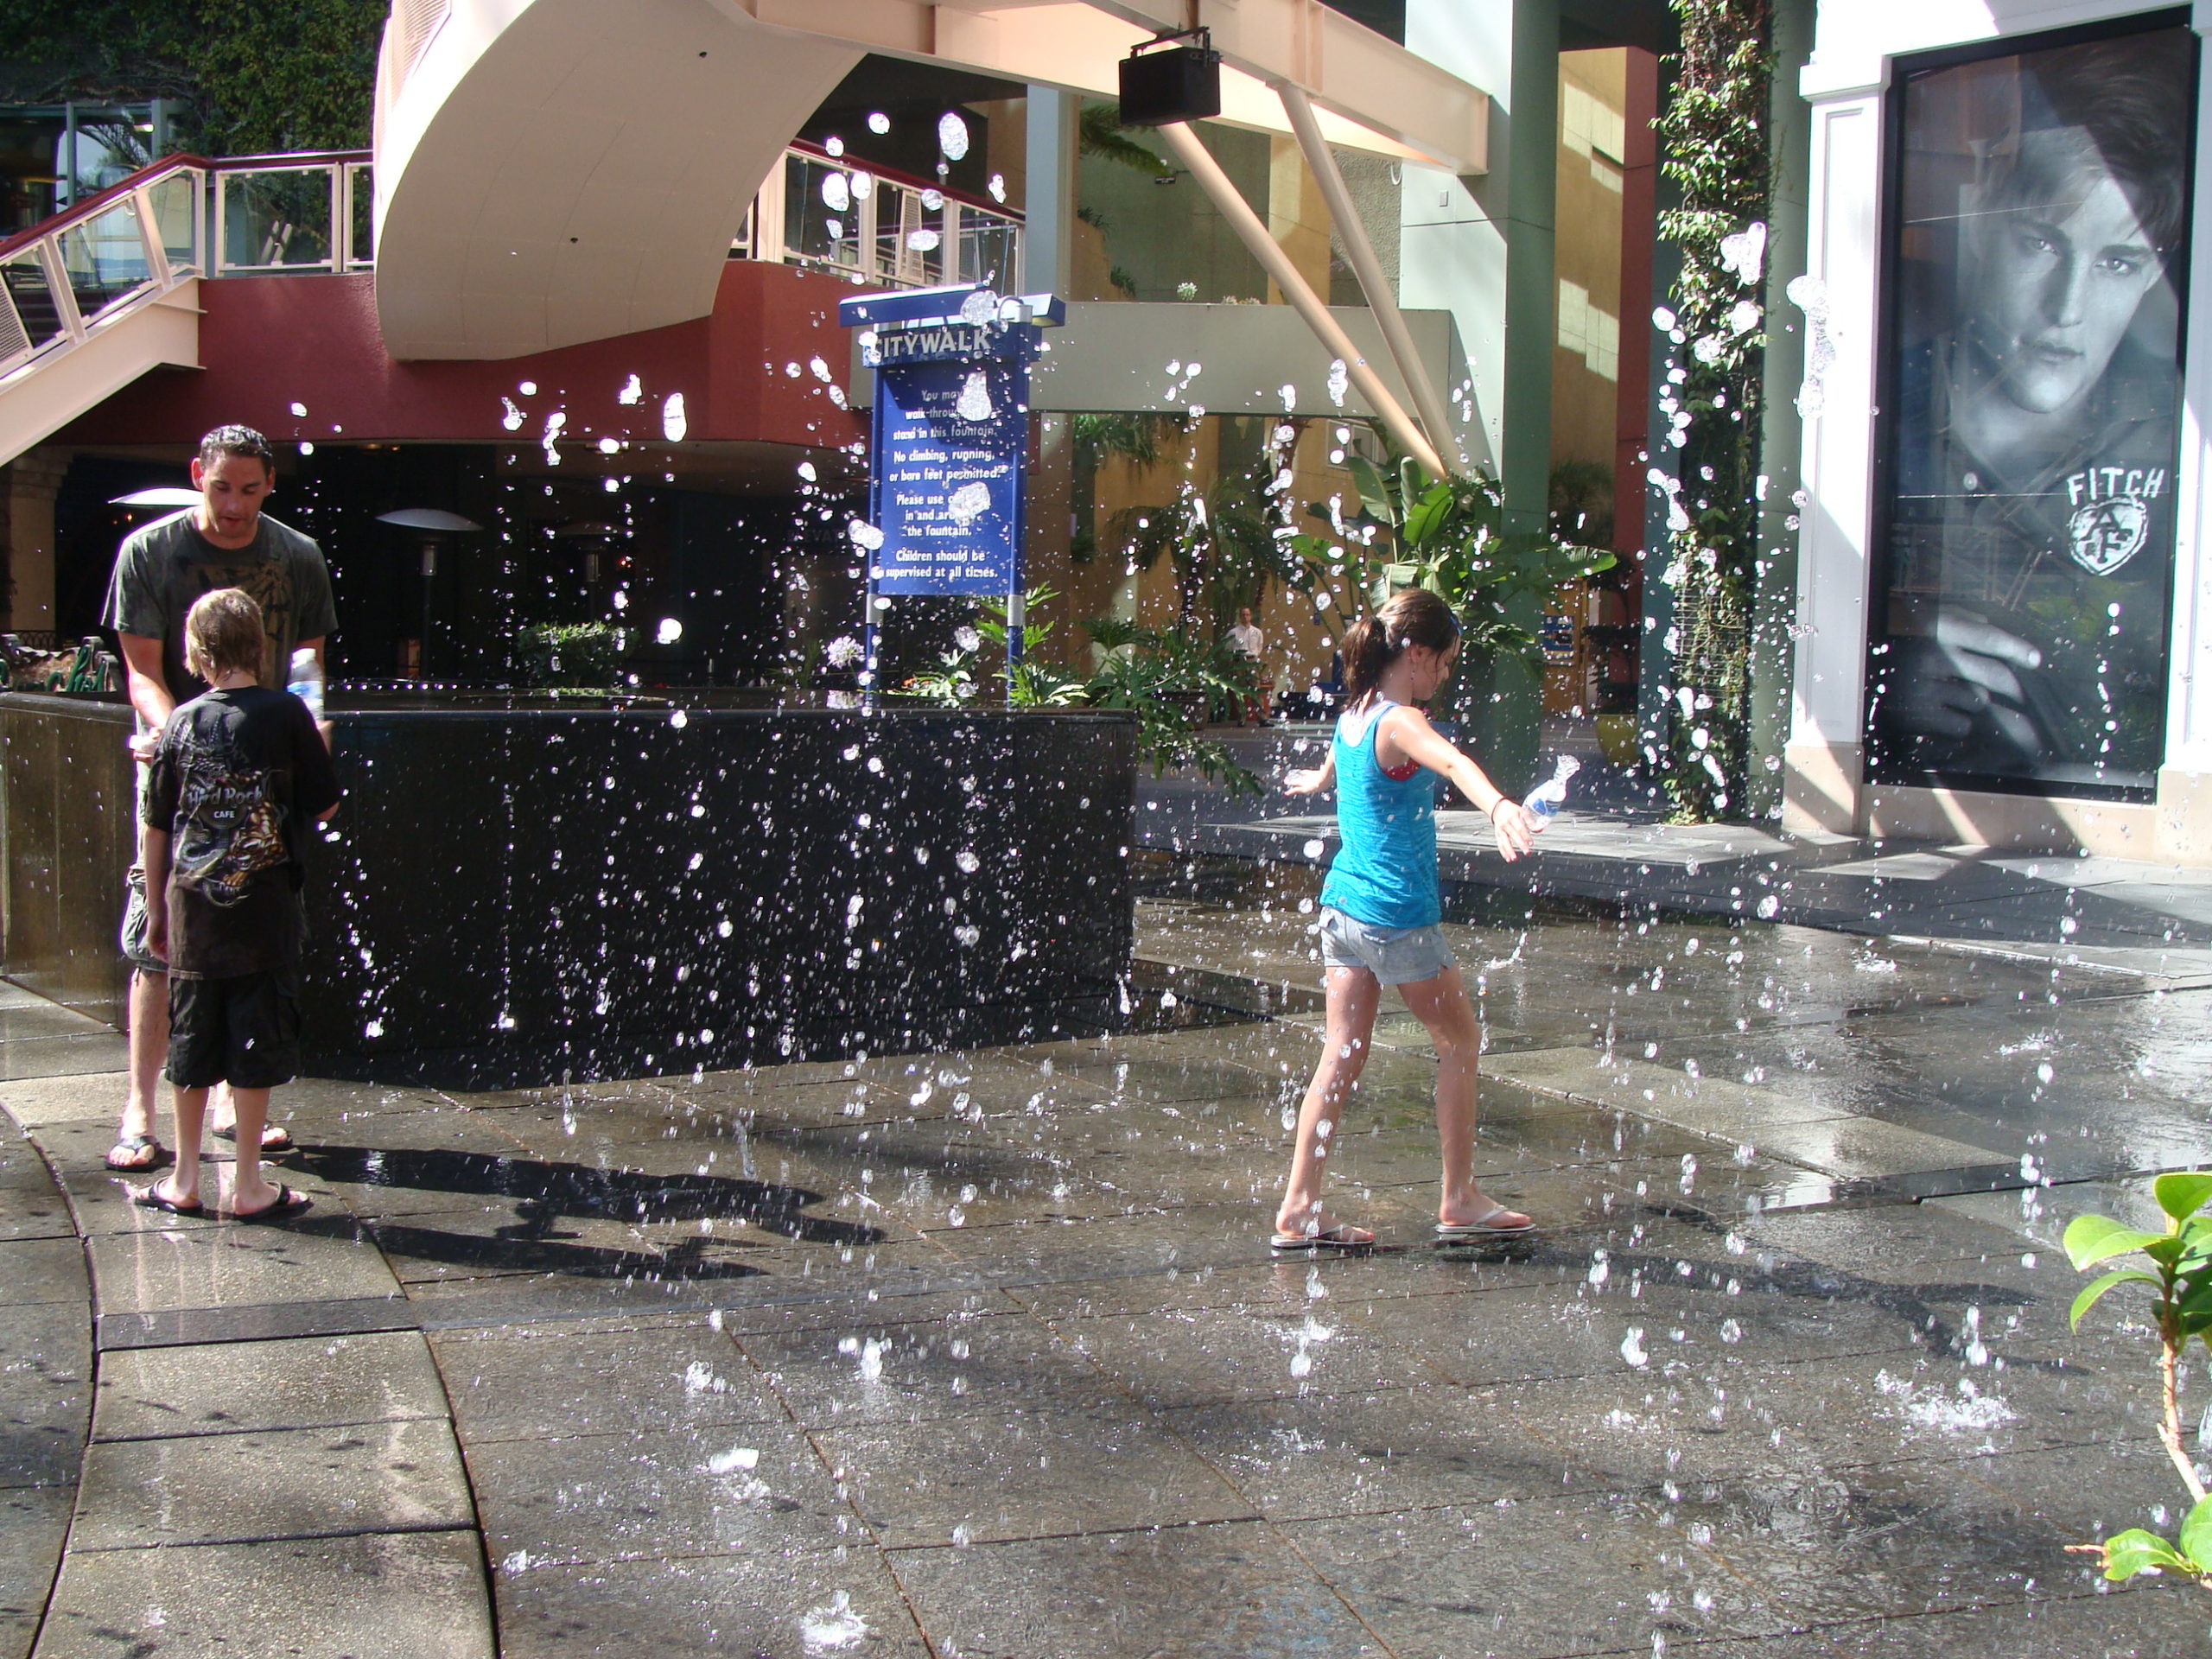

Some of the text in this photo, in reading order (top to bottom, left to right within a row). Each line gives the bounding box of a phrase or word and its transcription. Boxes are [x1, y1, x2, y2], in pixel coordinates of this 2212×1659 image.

[921, 390, 963, 401] You may
[905, 406, 963, 420] walk-throug
[893, 425, 997, 441] stand in this fountain.
[894, 448, 995, 463] No climbing, running,
[889, 467, 1001, 483] or bare feet permitted.
[2066, 467, 2164, 505] FITCH
[896, 493, 925, 505] Please
[927, 495, 944, 505] use
[905, 510, 914, 520] in
[917, 509, 935, 520] and
[907, 524, 972, 537] the fountain.
[896, 549, 986, 562] Children should be
[885, 566, 998, 580] supervised at all times.
[213, 810, 236, 819] CAFE
